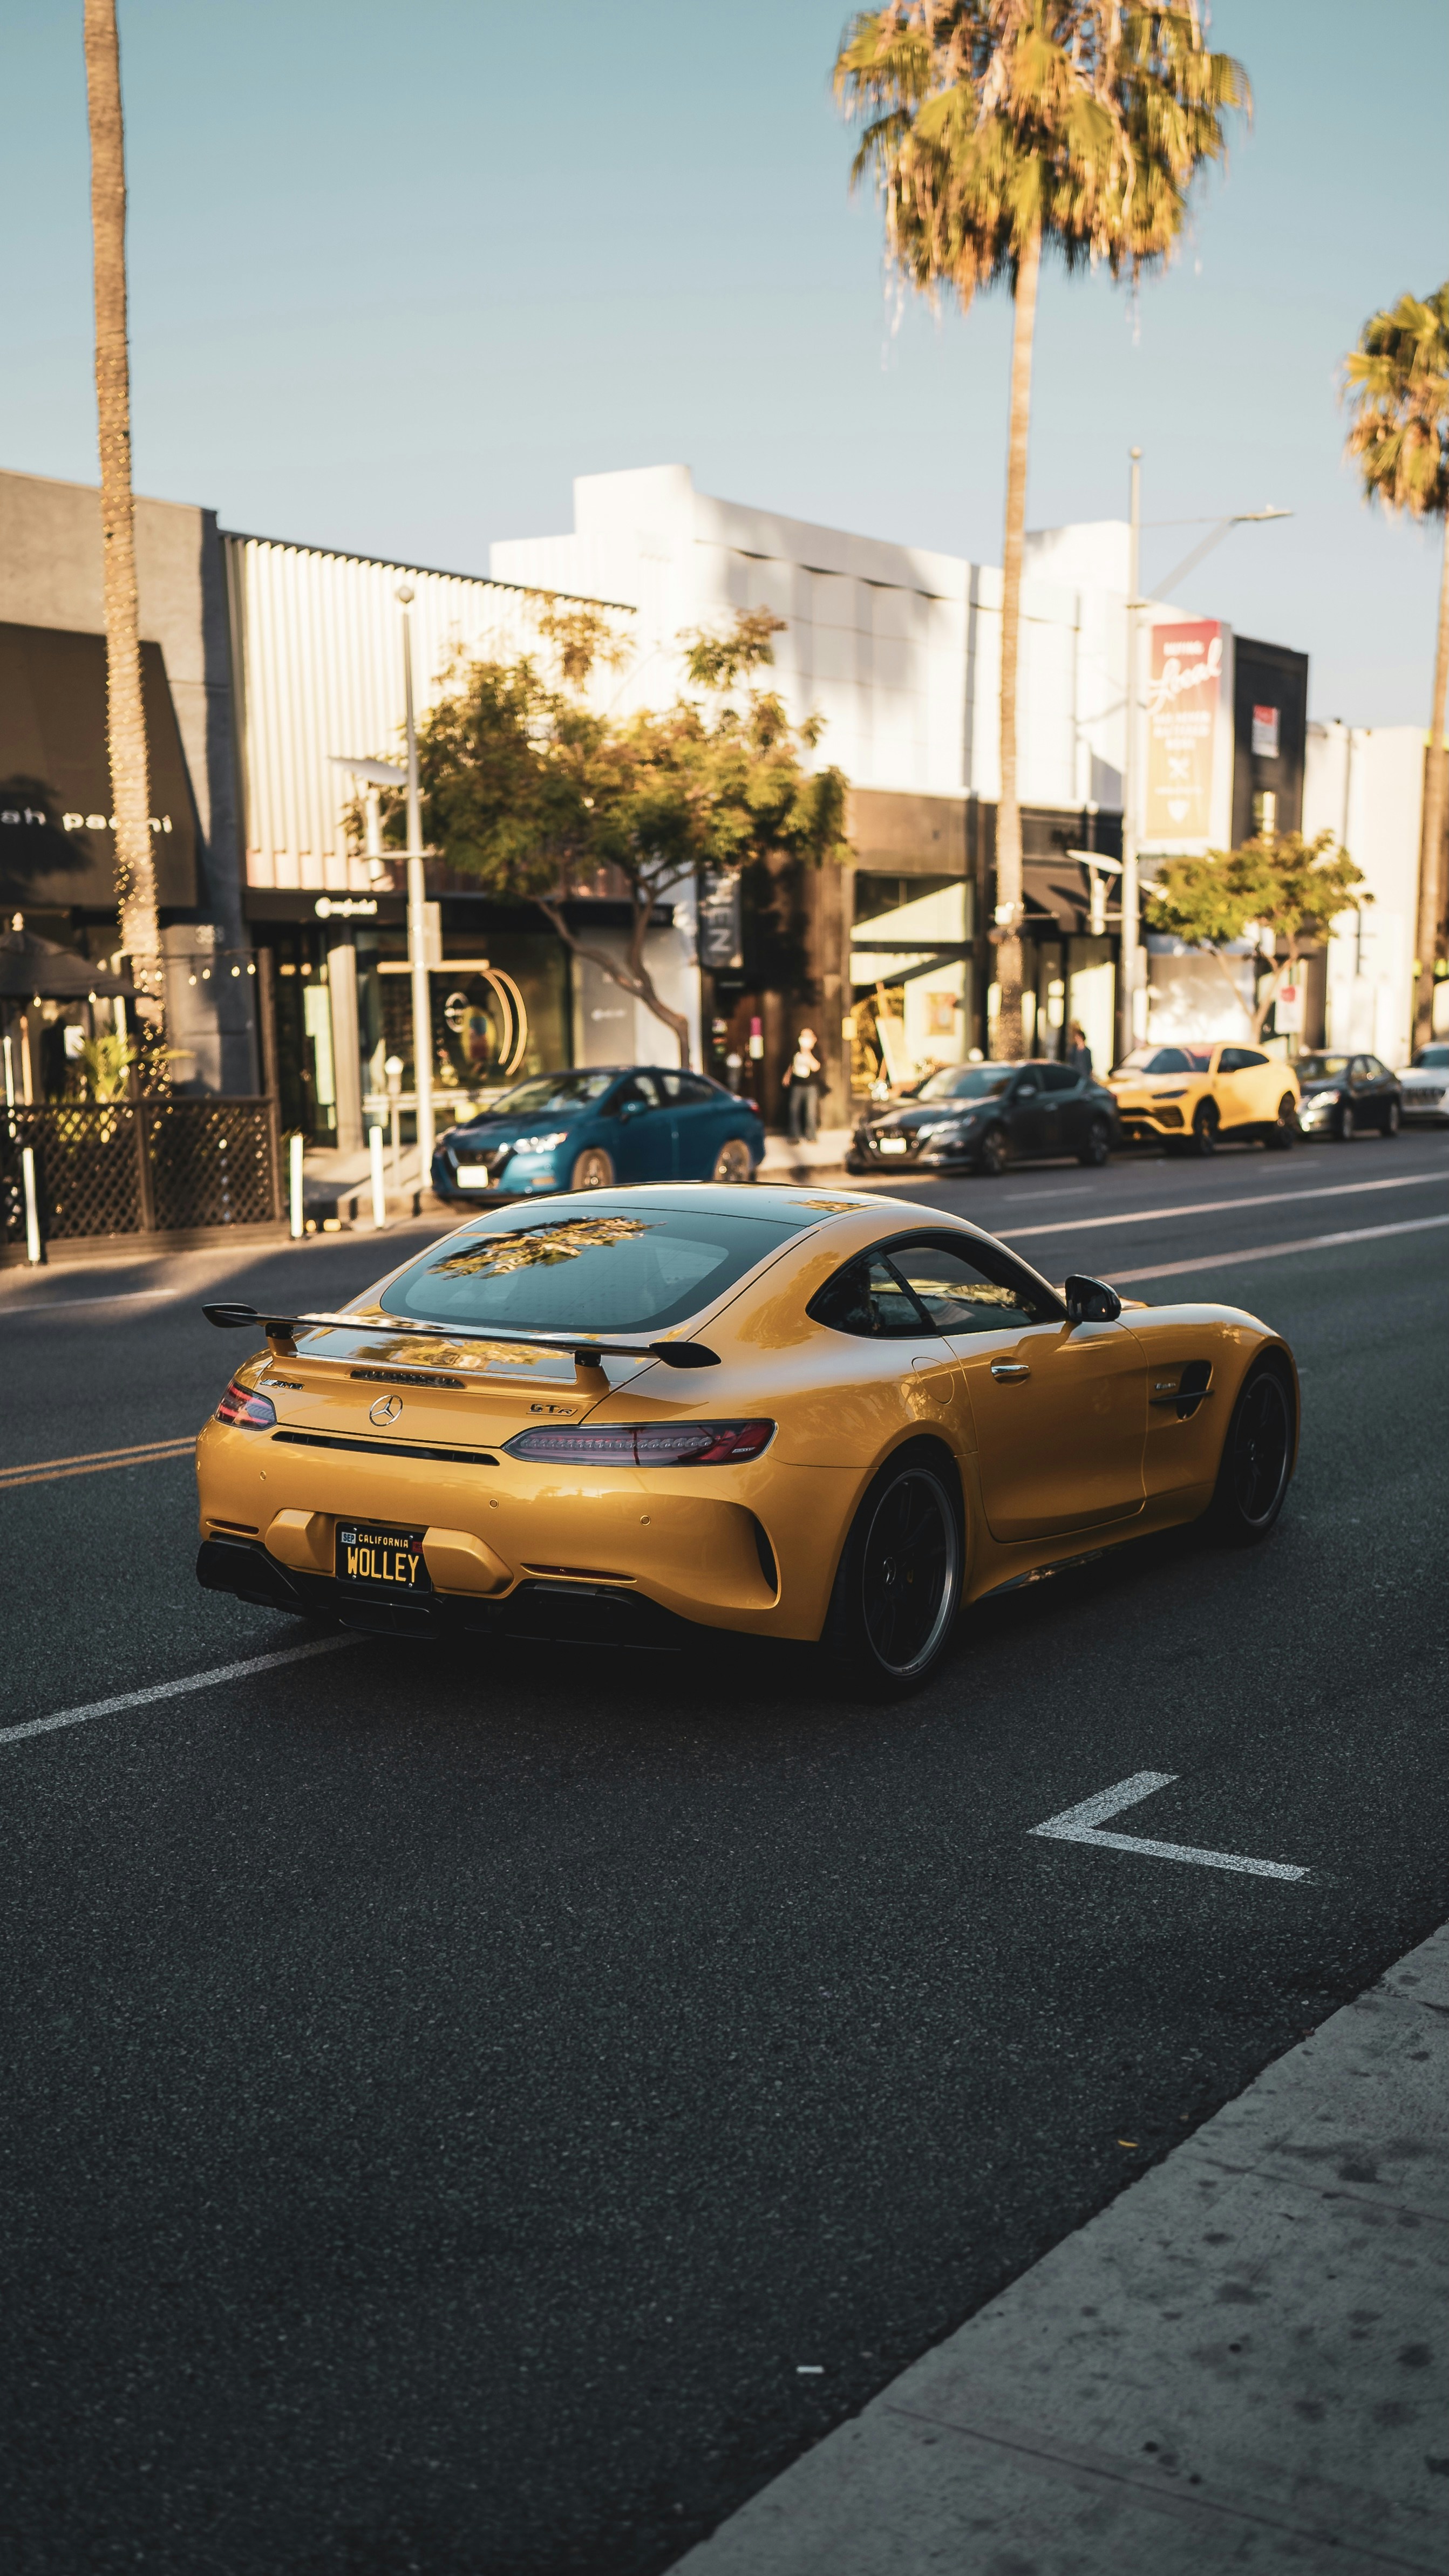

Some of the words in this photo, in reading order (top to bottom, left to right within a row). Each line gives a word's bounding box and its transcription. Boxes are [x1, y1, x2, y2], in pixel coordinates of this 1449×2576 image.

[343, 1533, 355, 1543] SEP
[358, 1534, 409, 1548] CALIFORNIA
[348, 1546, 419, 1583] WOLLEY
